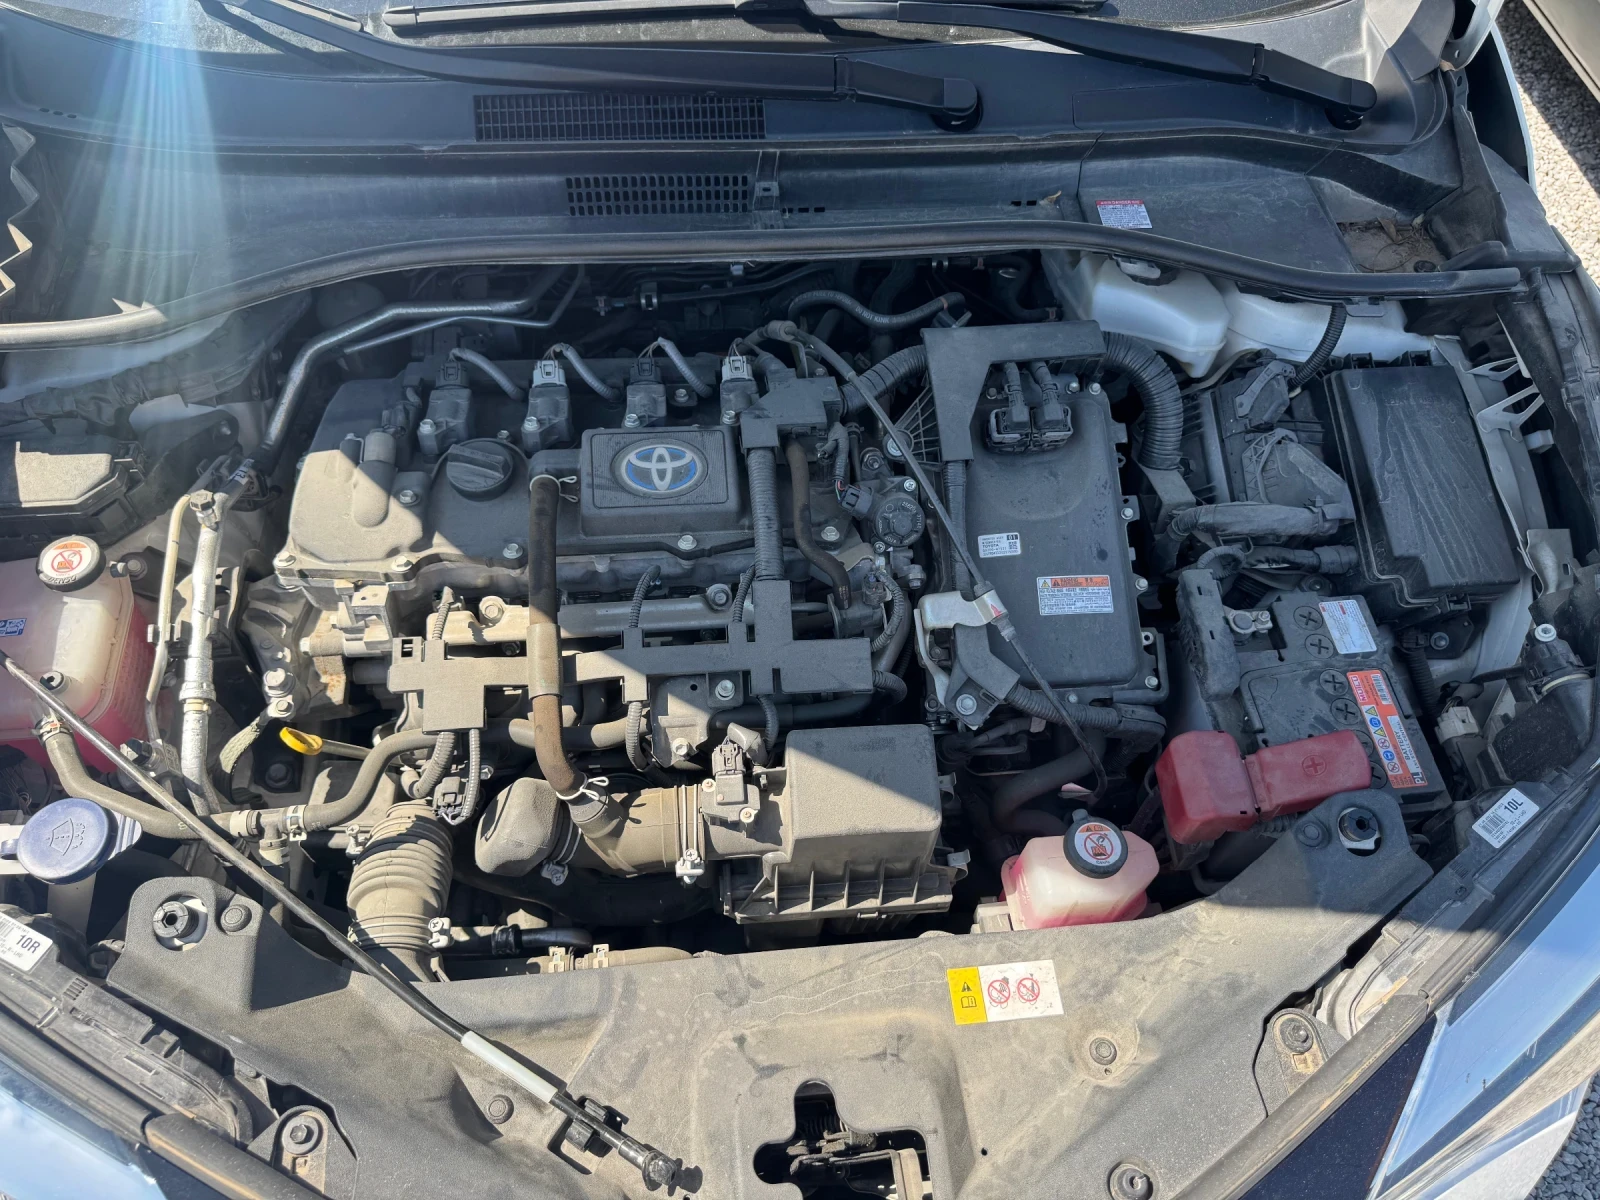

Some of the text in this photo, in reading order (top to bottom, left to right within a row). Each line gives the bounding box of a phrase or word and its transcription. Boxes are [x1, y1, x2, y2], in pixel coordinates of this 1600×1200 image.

[1394, 730, 1411, 760] BATTERY
[1413, 772, 1425, 784] PL
[1504, 798, 1523, 813] 10L
[16, 934, 41, 954] 10R
